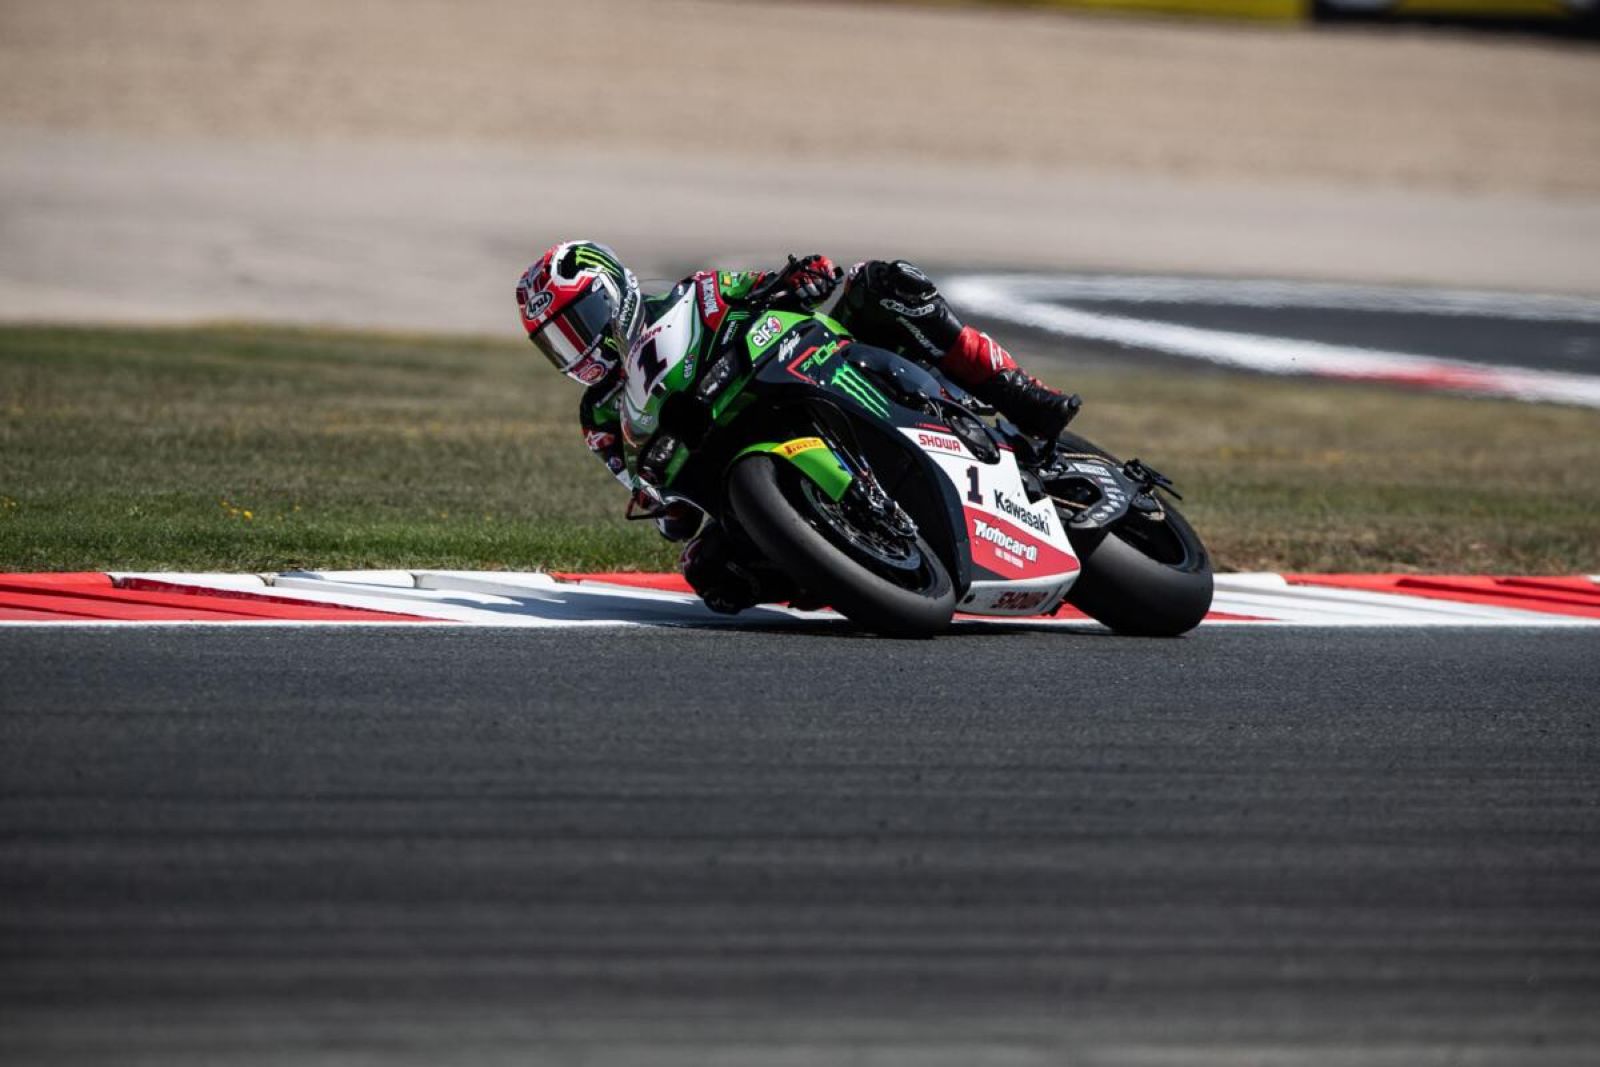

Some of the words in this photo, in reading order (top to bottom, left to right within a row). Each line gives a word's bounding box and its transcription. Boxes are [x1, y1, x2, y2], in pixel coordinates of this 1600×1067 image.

[752, 319, 777, 347] elf
[637, 338, 668, 395] 1
[918, 434, 961, 452] SHOWA
[965, 465, 983, 505] 1
[994, 489, 1051, 537] Kawasaki
[973, 520, 1037, 564] Motocard
